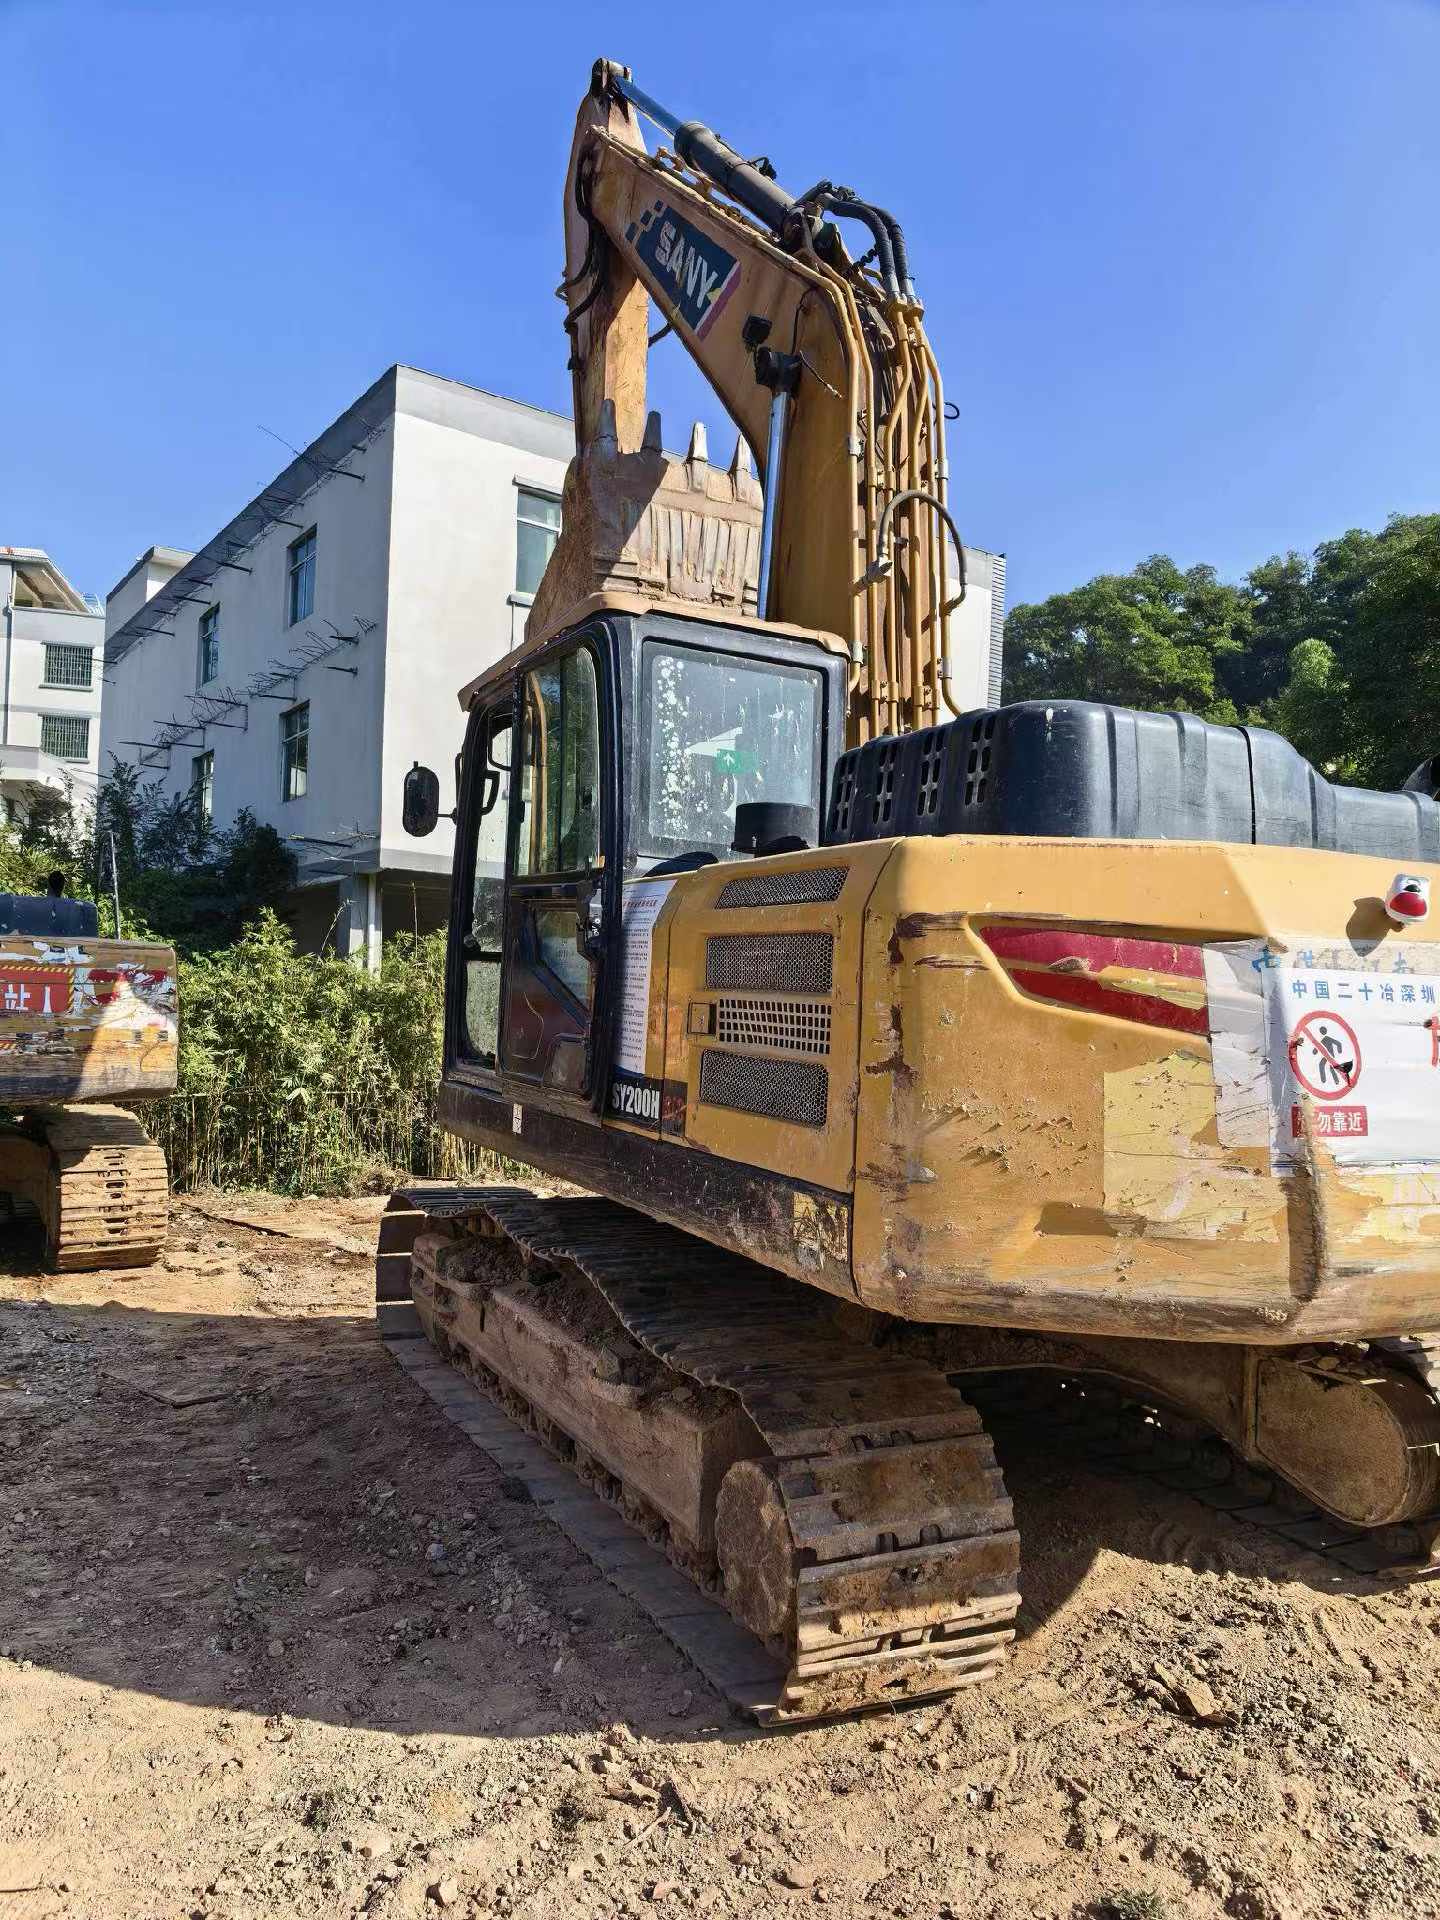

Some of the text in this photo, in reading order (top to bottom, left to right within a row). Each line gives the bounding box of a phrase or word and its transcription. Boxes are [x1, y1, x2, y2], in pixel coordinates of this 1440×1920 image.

[655, 220, 719, 309] SANY
[1292, 979, 1436, 1004] 中国二十冶深圳
[612, 1082, 660, 1119] SY200H
